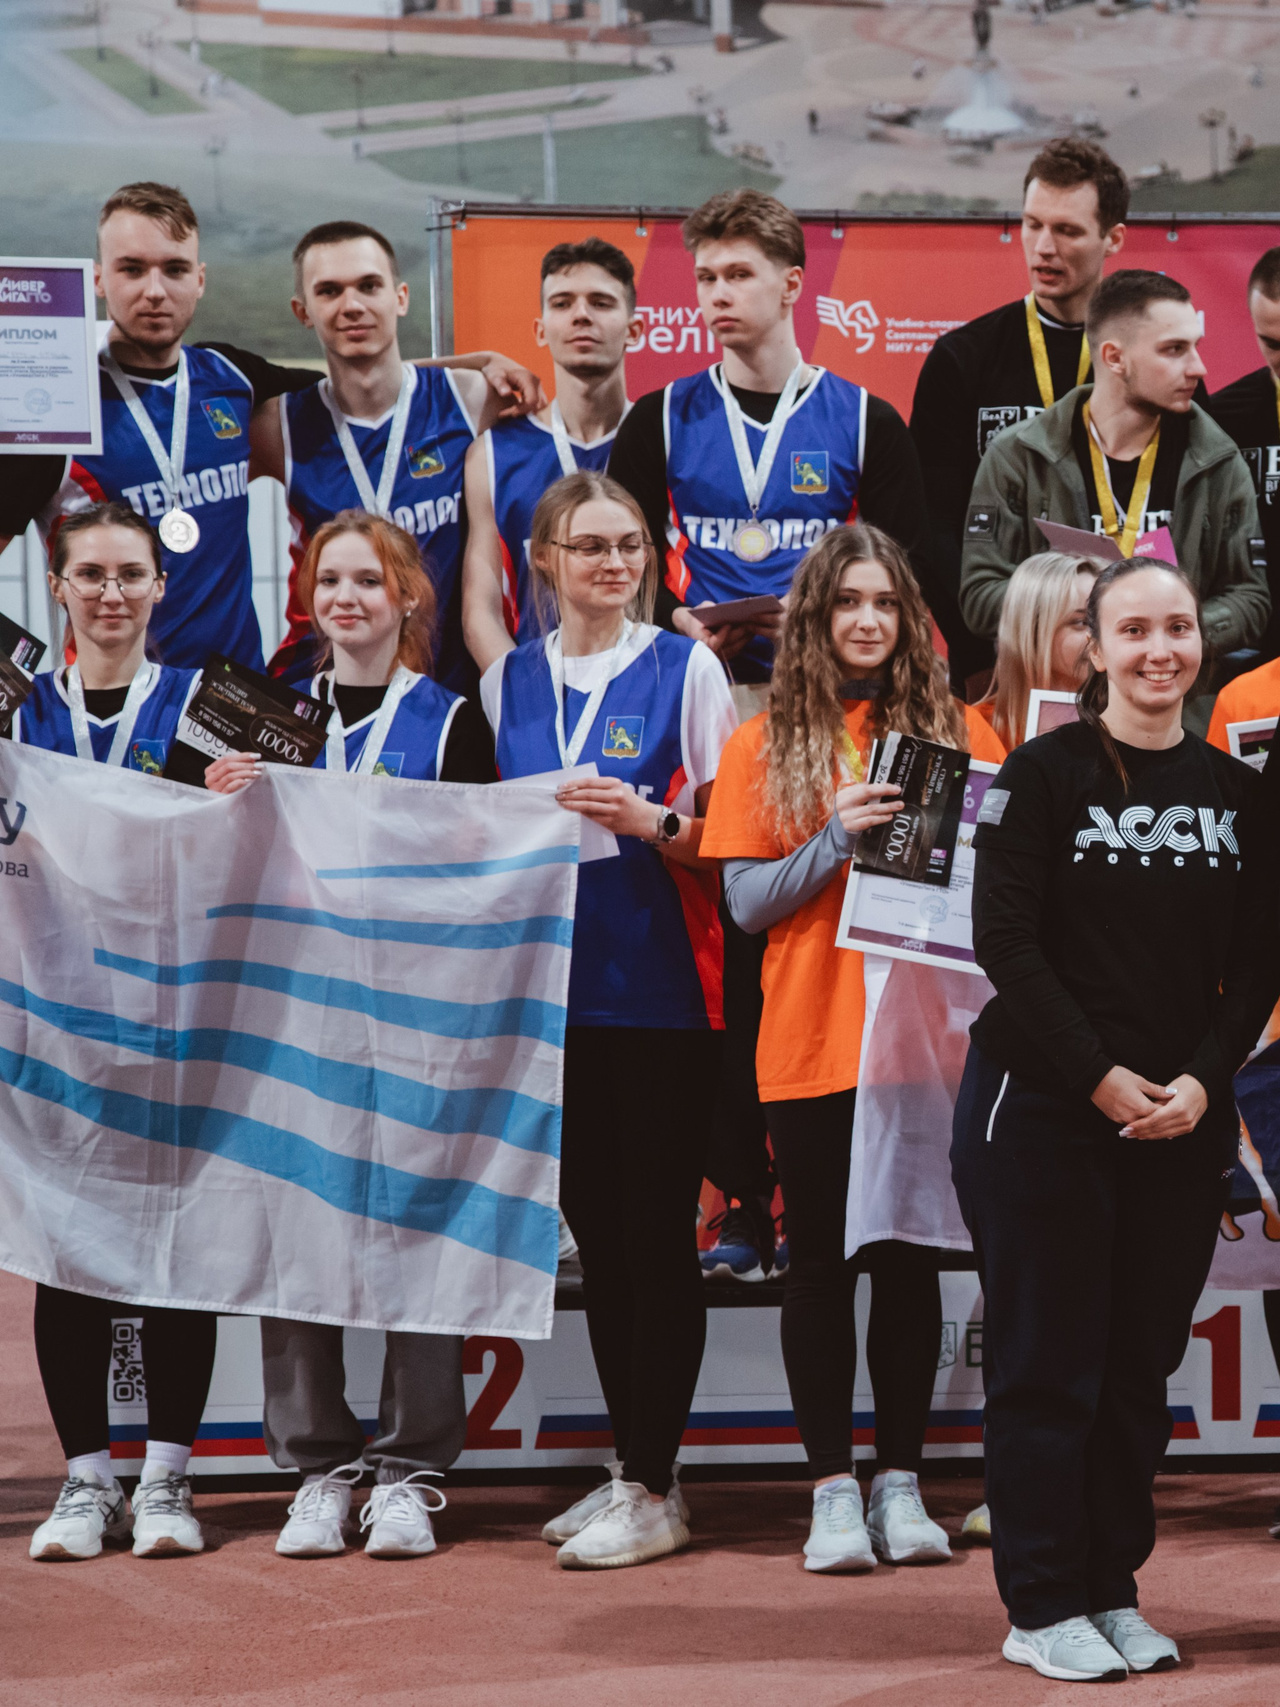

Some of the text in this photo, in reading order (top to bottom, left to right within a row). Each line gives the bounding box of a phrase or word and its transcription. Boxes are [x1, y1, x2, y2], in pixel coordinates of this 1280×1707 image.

[0, 277, 46, 296] НИВЕР
[1075, 805, 1240, 855] АССК
[462, 1335, 524, 1451] 2
[1191, 1305, 1242, 1422] 1
